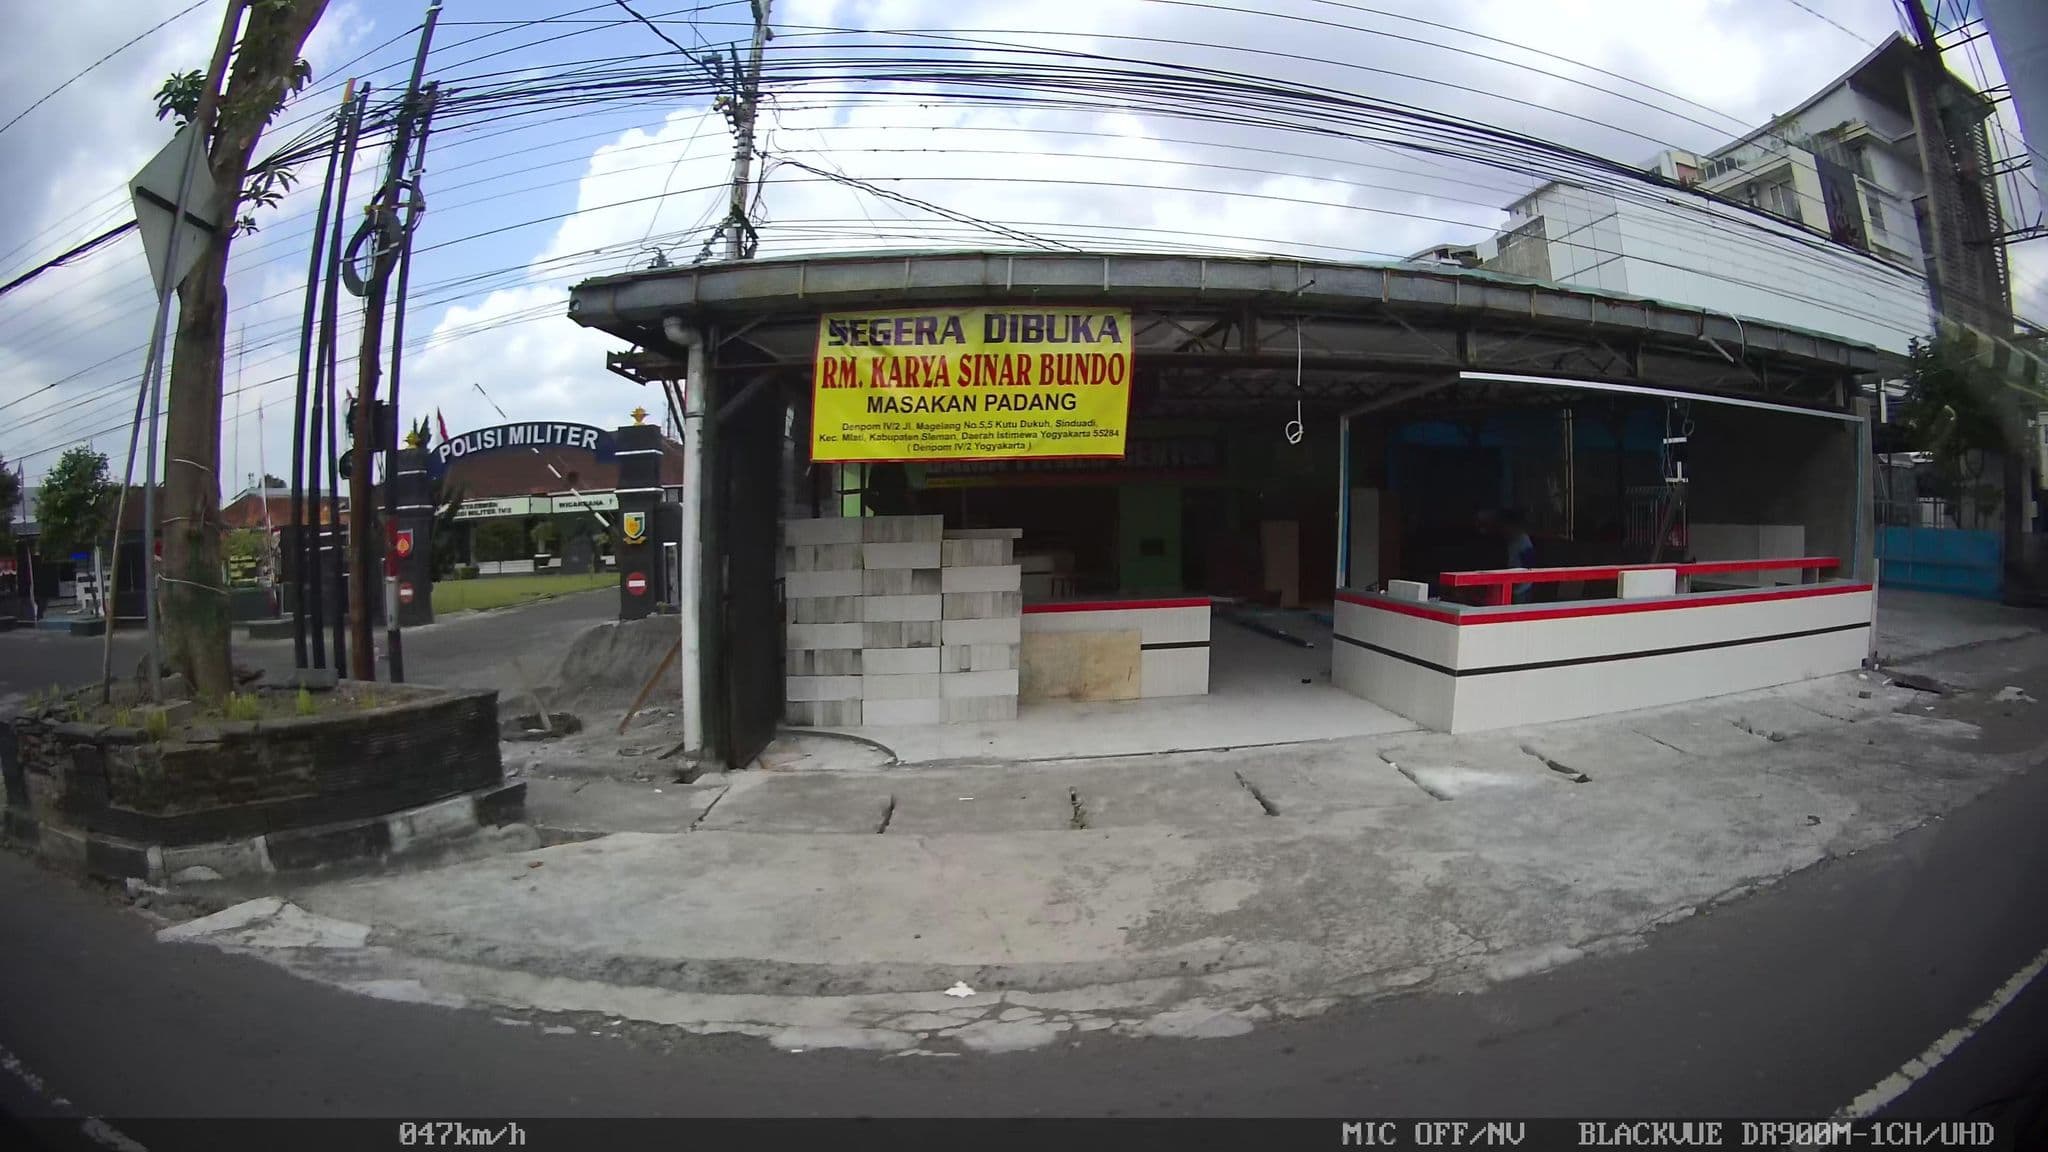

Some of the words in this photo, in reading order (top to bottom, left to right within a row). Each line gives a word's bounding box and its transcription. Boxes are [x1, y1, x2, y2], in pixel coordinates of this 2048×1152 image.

[829, 315, 967, 347] SEGERA
[984, 313, 1123, 344] DIBUKA
[821, 356, 864, 389] RM.
[870, 355, 951, 389] KARYA
[957, 353, 1032, 388] SINAR
[1039, 352, 1126, 386] BUNDO
[867, 394, 977, 414] MASAKAN
[984, 392, 1077, 412] PADANG
[842, 422, 881, 432] Denpom
[916, 420, 961, 432] Magelang
[995, 419, 1018, 429] Kutu
[869, 432, 919, 444] Kabupaten
[961, 430, 994, 440] Daerah
[996, 429, 1038, 440] Istimewa
[1041, 428, 1090, 441] Yogyakarta
[1092, 428, 1120, 438] 55284
[439, 428, 502, 464] POLISI
[508, 423, 599, 450] MILITER
[912, 442, 952, 453] Denpom
[975, 440, 1026, 452] Yogyakarta
